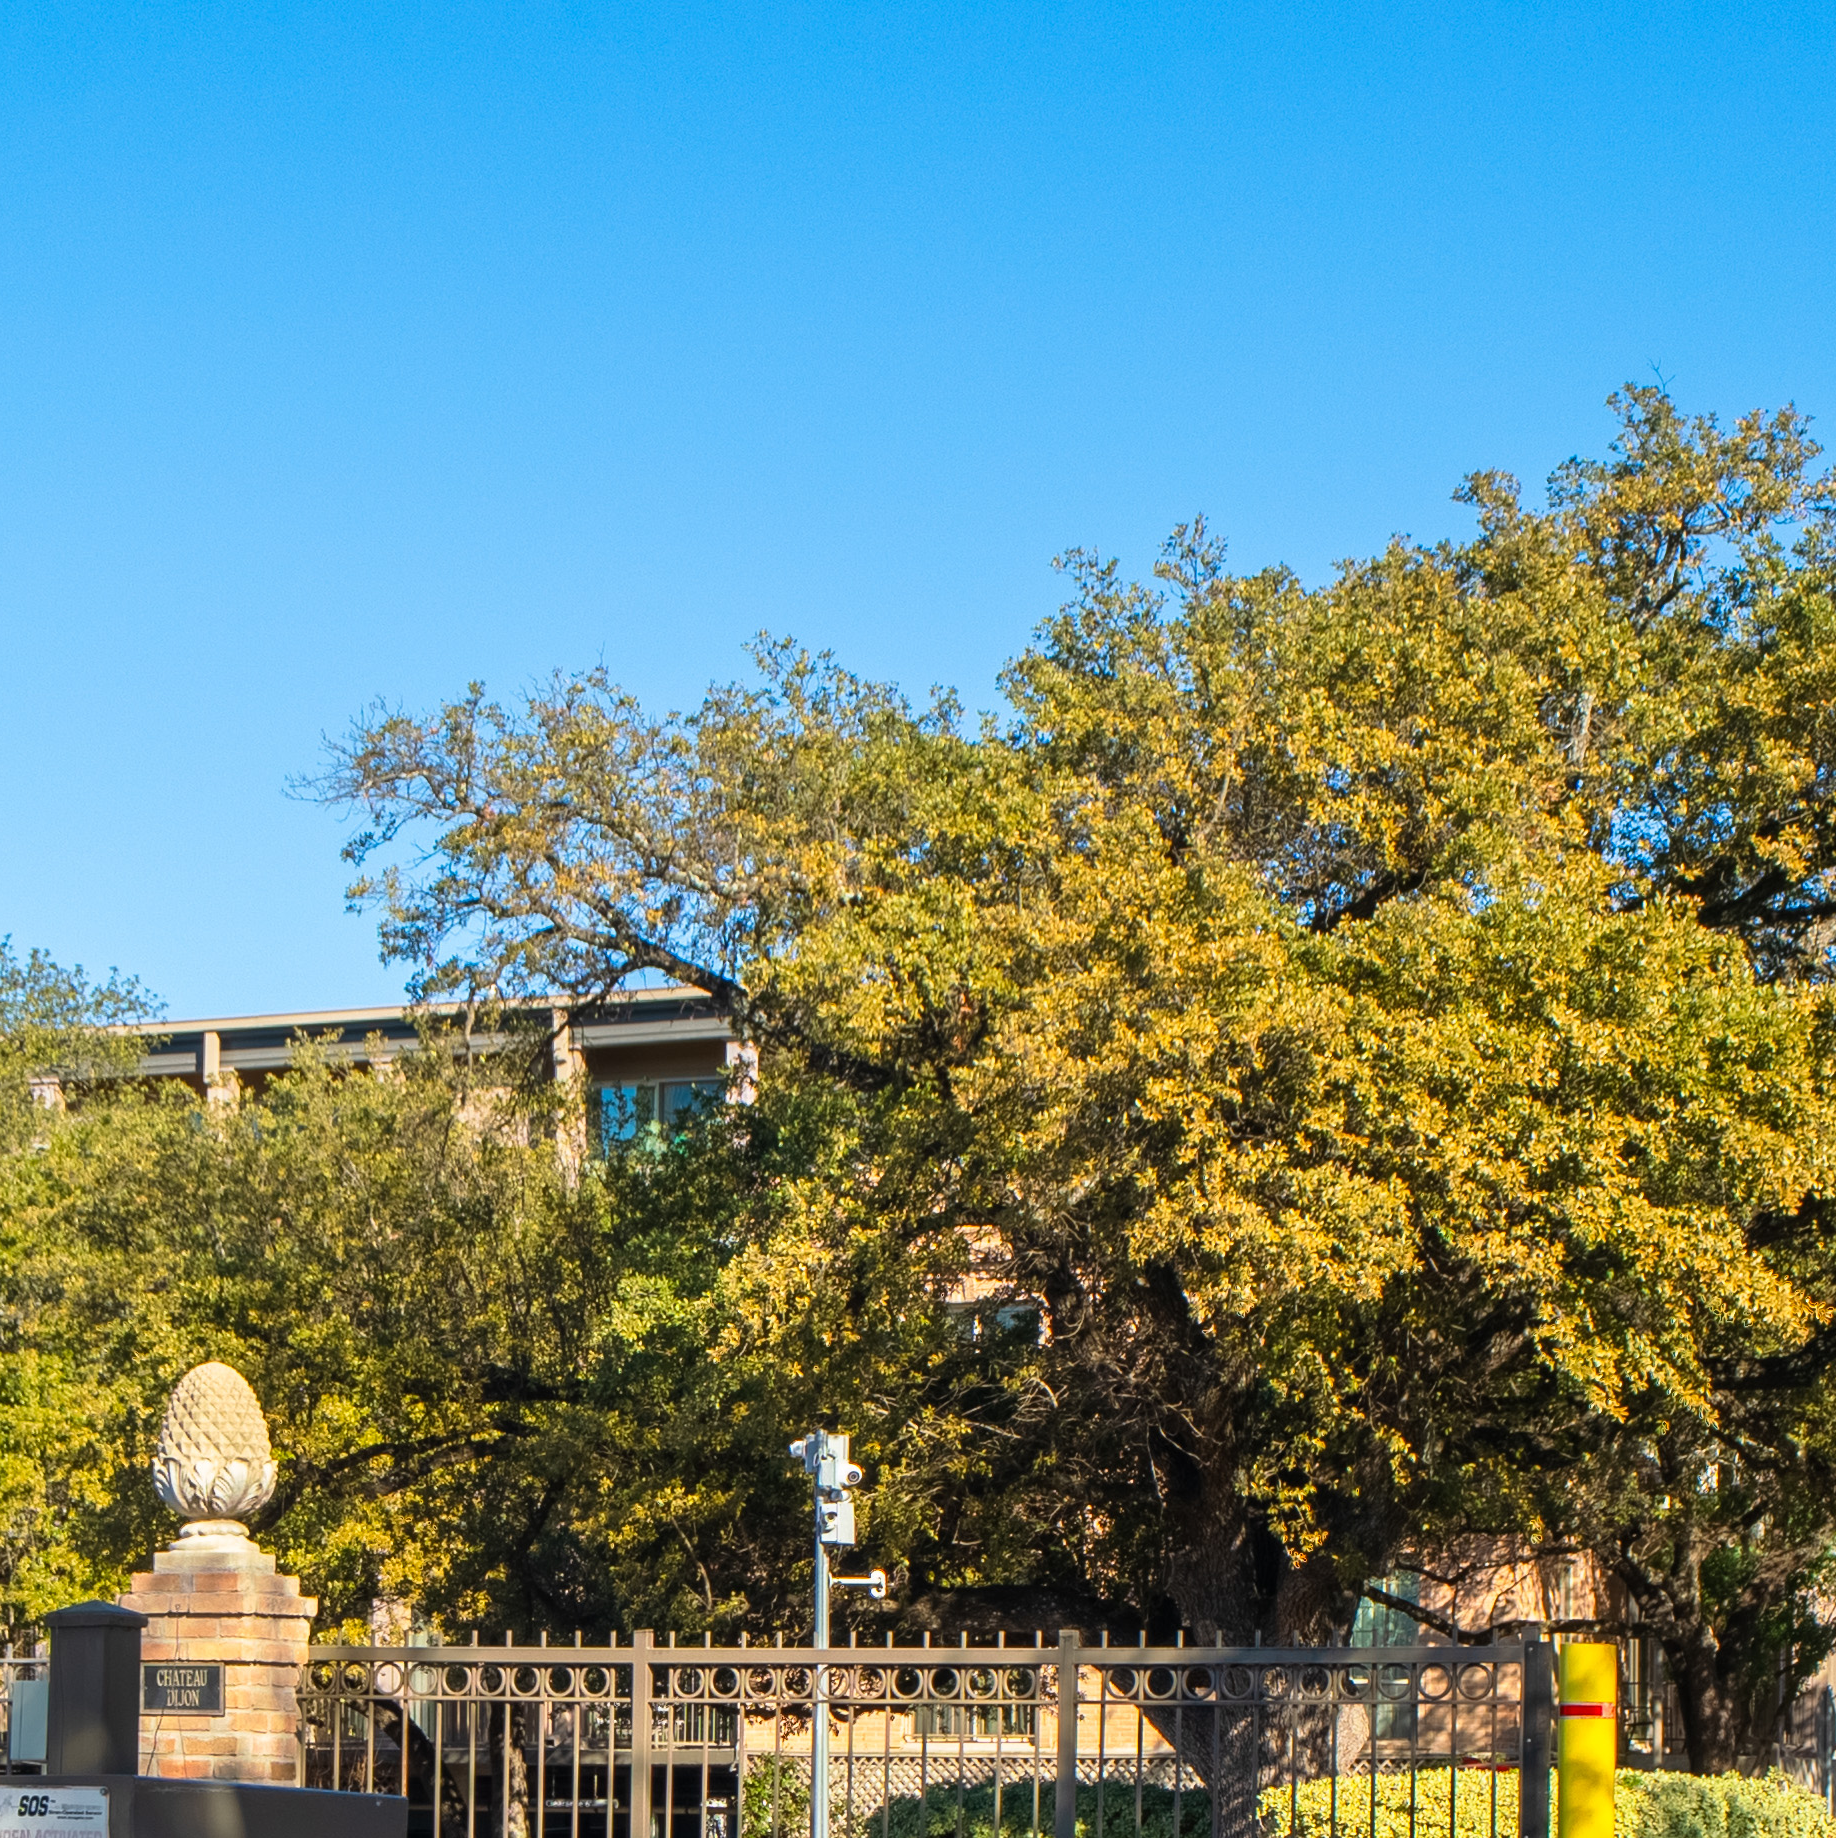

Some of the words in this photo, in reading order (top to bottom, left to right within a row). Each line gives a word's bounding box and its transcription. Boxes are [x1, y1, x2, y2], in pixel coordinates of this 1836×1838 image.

[157, 1670, 207, 1686] CHATEAU
[167, 1690, 200, 1706] DIJON
[18, 1795, 49, 1817] SOS
